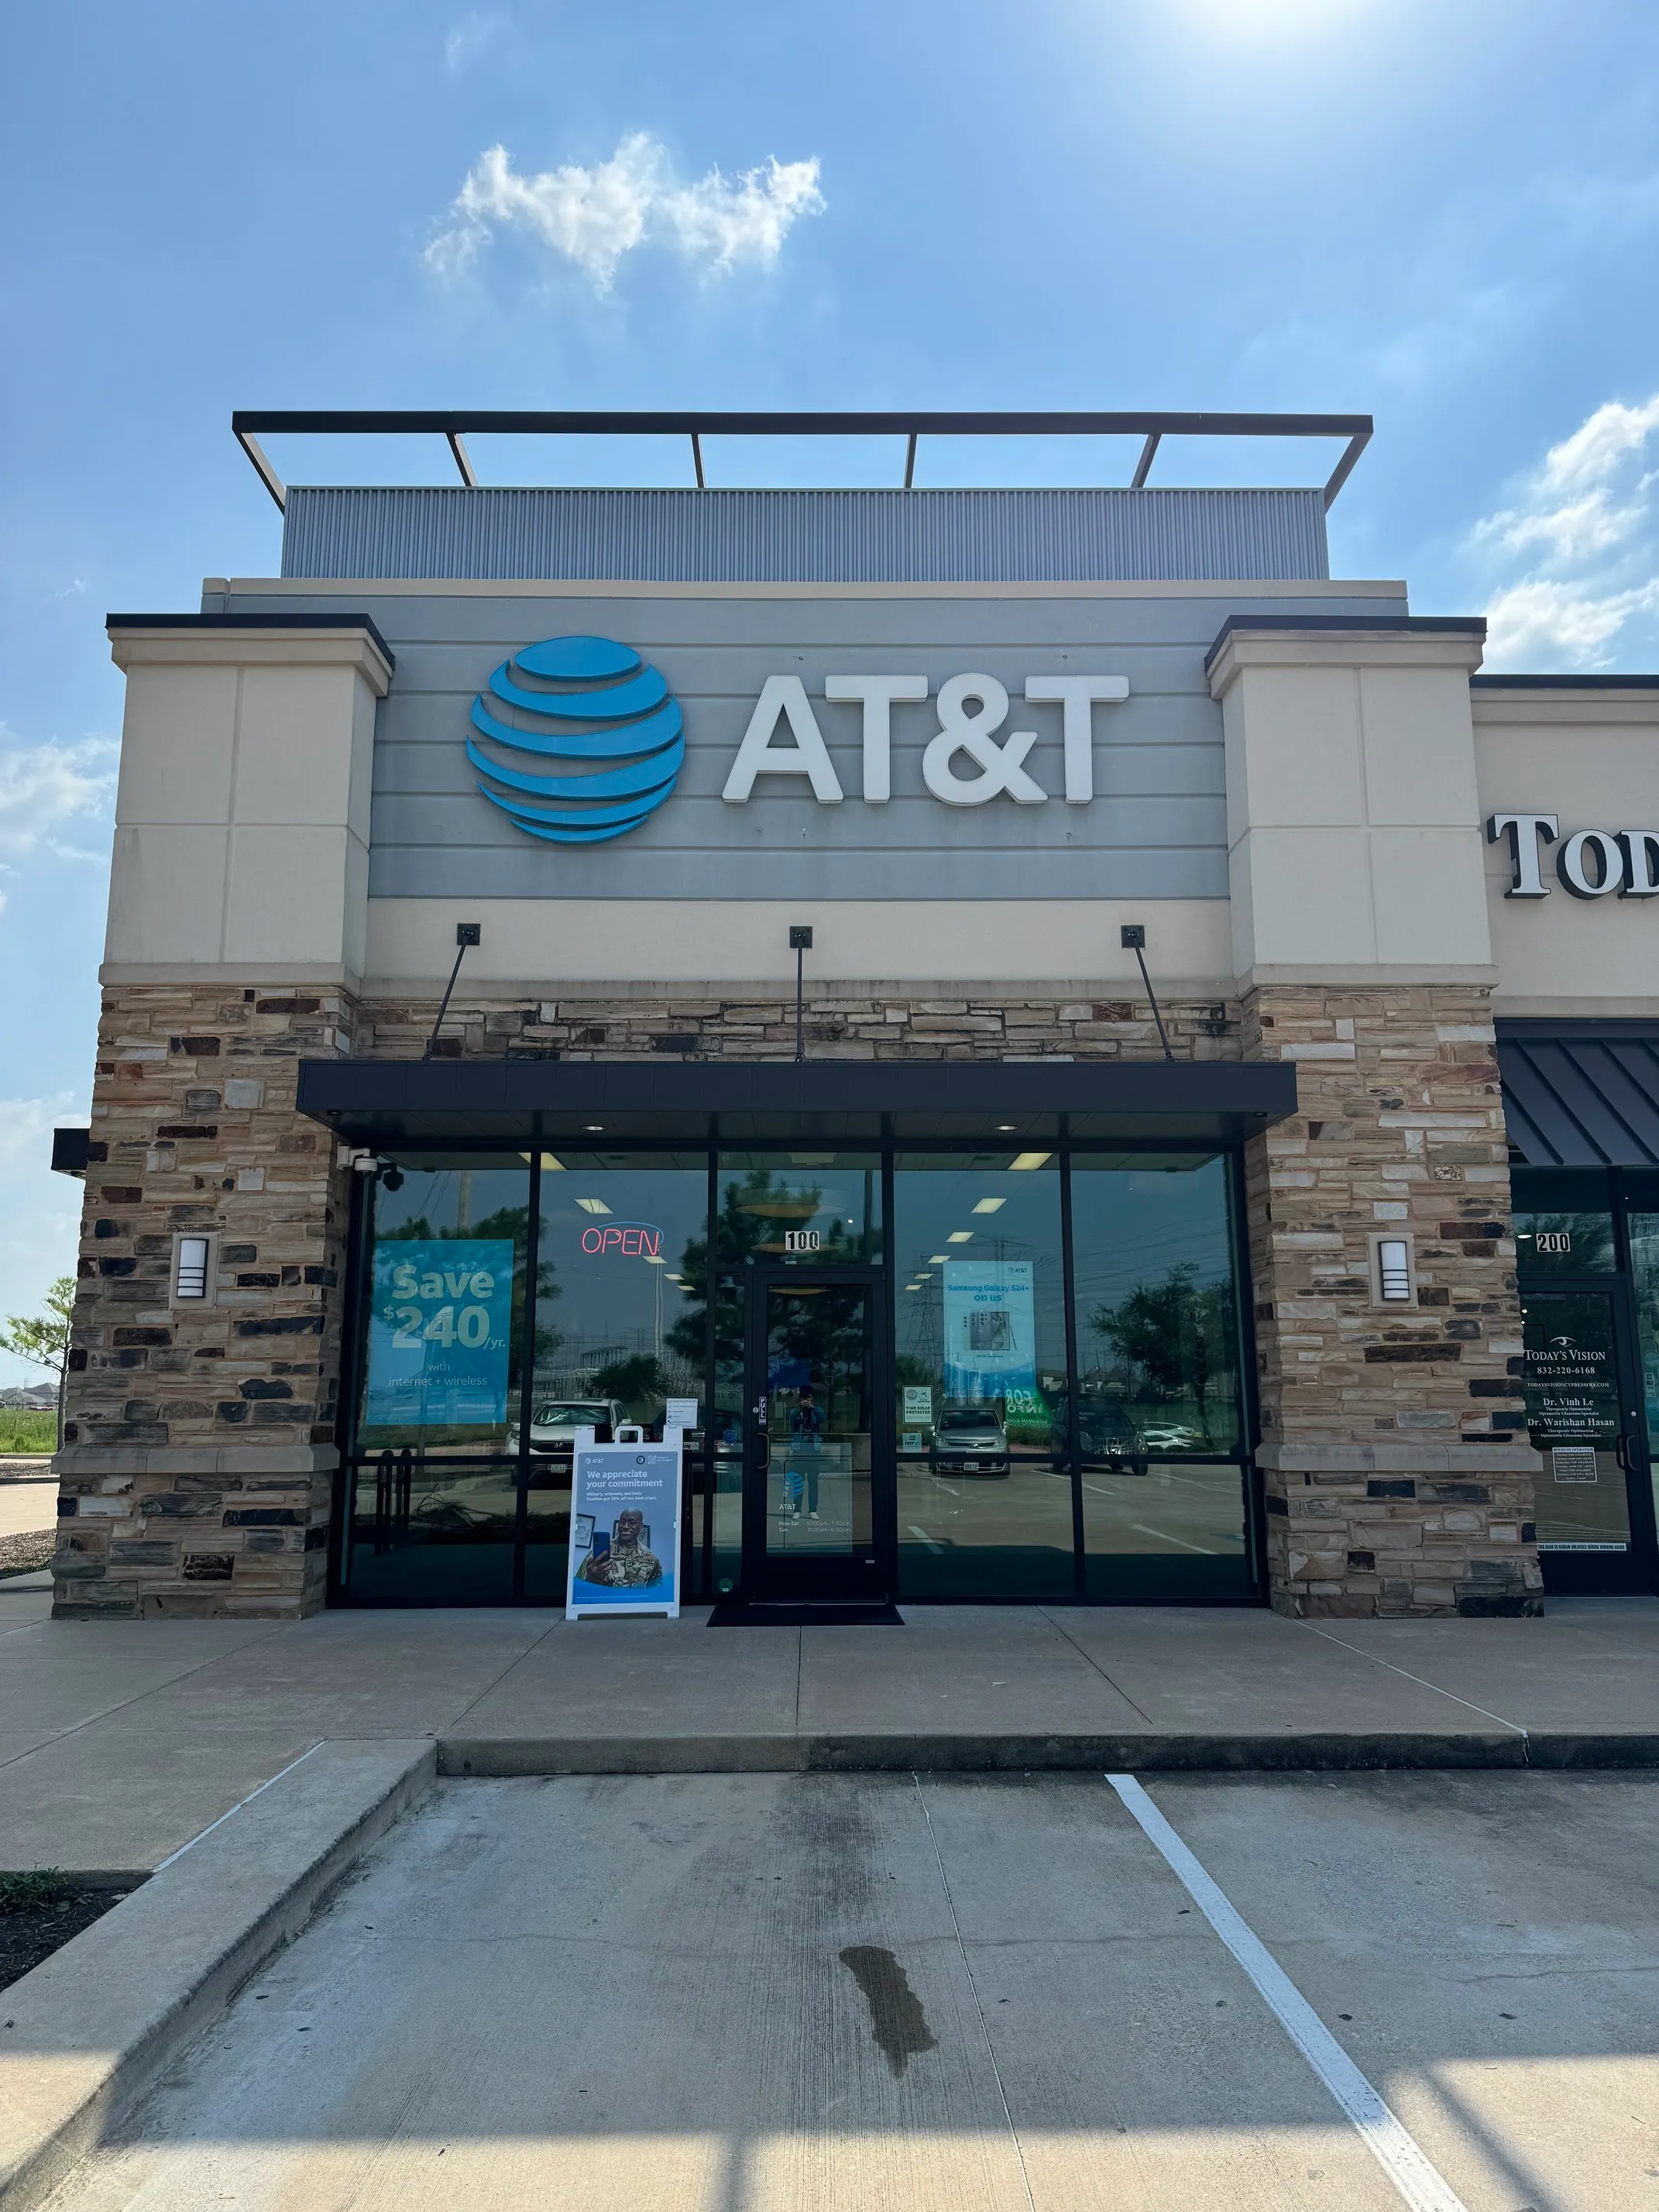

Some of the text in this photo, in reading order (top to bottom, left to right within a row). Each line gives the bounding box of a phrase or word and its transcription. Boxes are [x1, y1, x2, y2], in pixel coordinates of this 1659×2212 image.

[723, 672, 1129, 805] AT&T
[582, 1228, 660, 1256] OPEN
[788, 1231, 818, 1249] 100
[1537, 1234, 1569, 1252] 200
[391, 1264, 495, 1299] Save
[947, 1284, 983, 1293] Samsung
[984, 1284, 1009, 1293] Galaxy
[1523, 1349, 1606, 1361] TODAY'S VISION
[428, 1362, 450, 1372] with
[389, 1376, 433, 1386] internet
[444, 1376, 488, 1386] wireless
[1543, 1397, 1594, 1406] Dr. Vinh Le
[1527, 1417, 1615, 1427] Dr. Warishan Hasan
[602, 1469, 647, 1480] appreciate
[586, 1479, 663, 1490] your commitment
